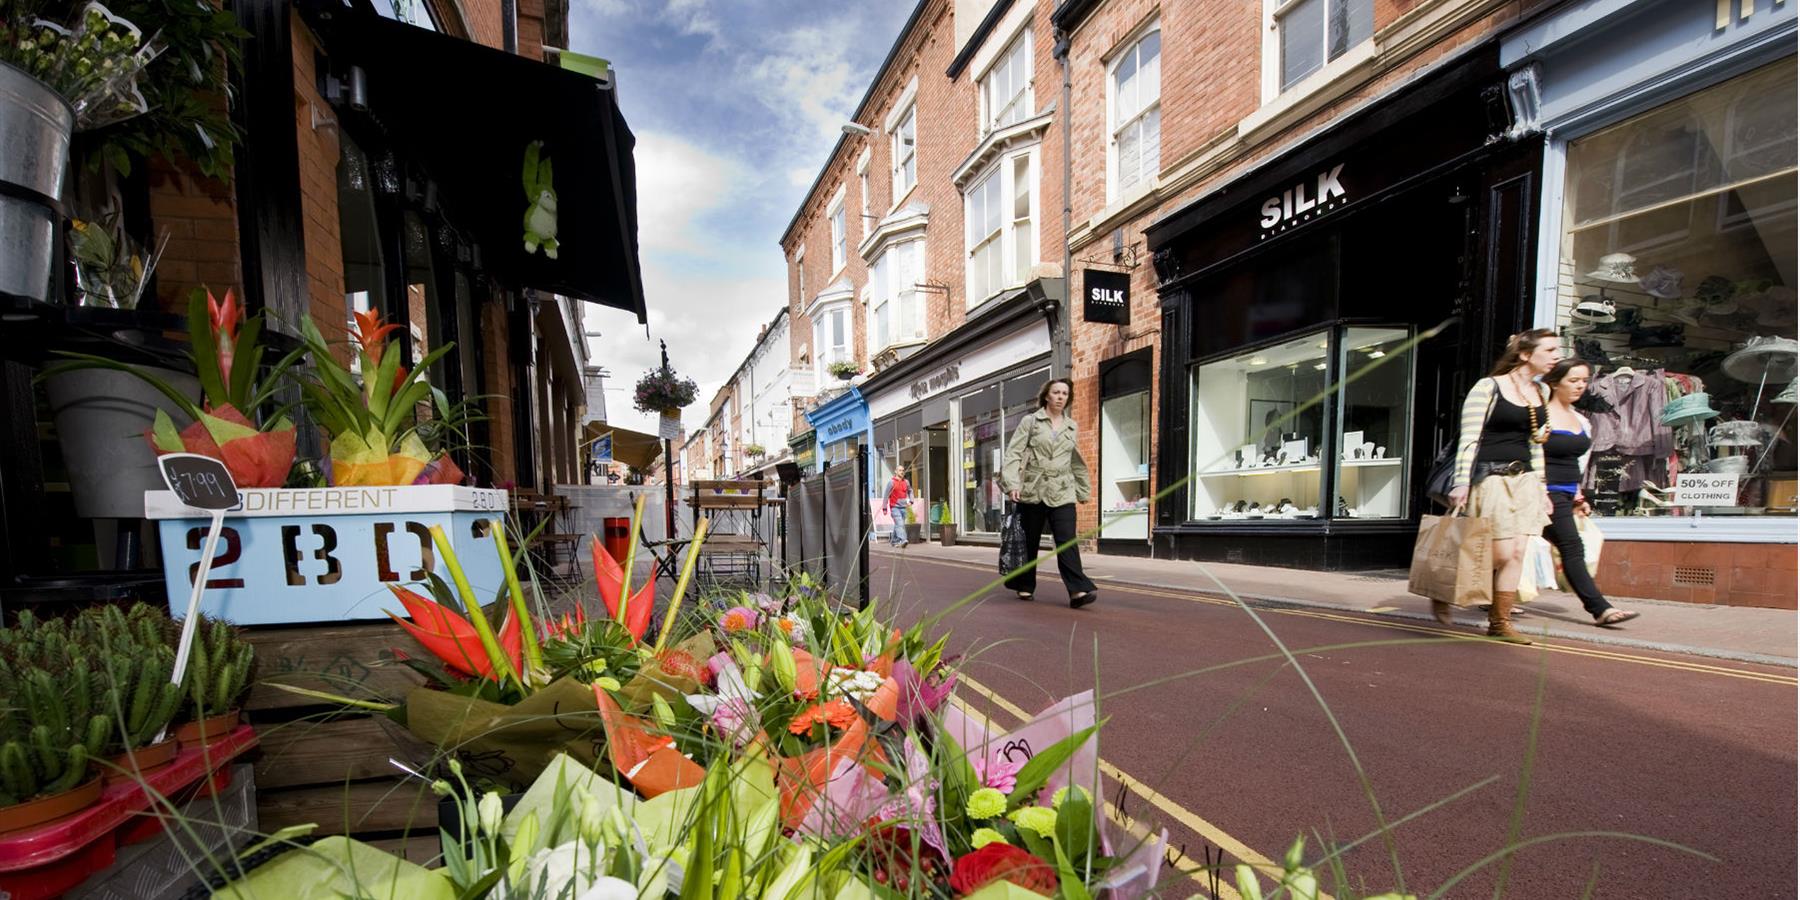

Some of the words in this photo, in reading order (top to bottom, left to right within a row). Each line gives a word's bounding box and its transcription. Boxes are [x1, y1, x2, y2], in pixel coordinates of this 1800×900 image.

[1260, 163, 1346, 229] SILK
[1261, 197, 1347, 240] DIAMONDS
[1091, 287, 1124, 304] SILK
[1681, 479, 1708, 488] 50%
[1711, 480, 1735, 488] OFF
